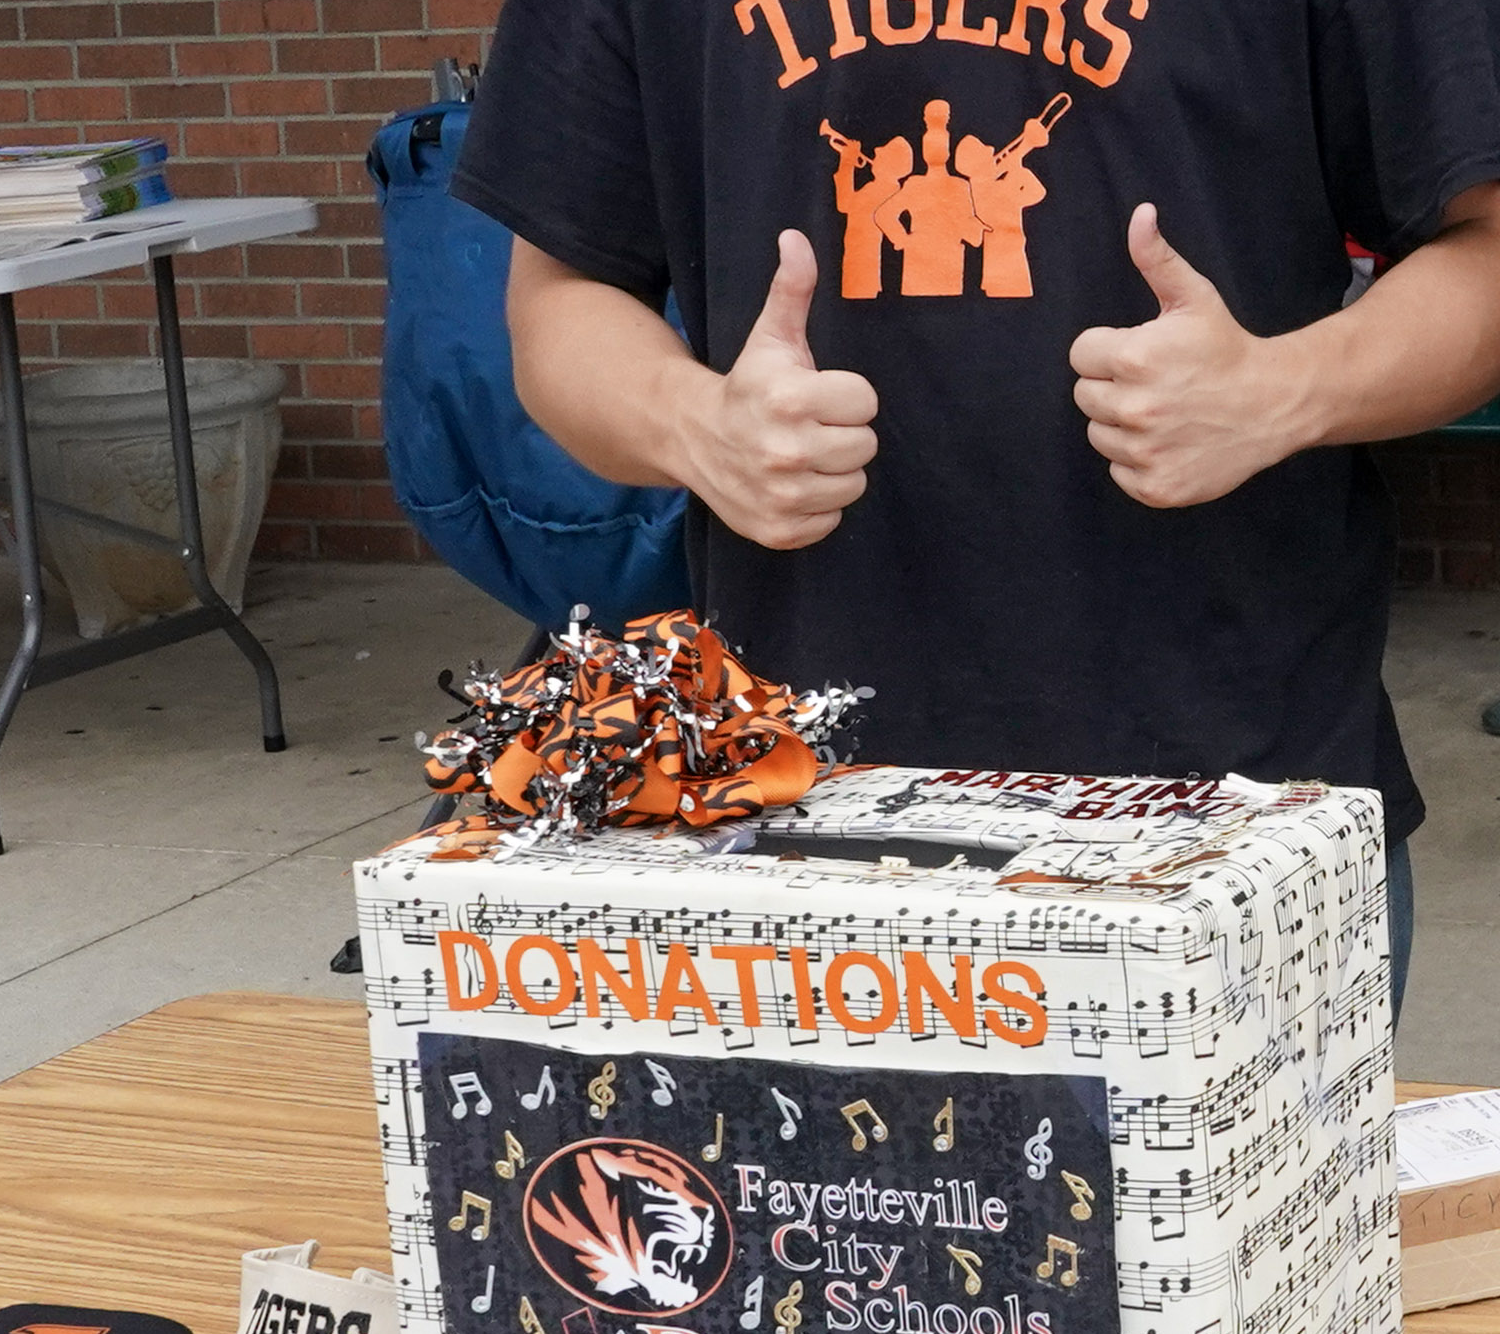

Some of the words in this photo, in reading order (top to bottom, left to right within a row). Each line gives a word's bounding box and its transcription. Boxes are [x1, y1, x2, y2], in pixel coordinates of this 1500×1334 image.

[438, 929, 1049, 1047] DONATIONS
[736, 1161, 1010, 1235] Fayetteville
[770, 1219, 903, 1288] City
